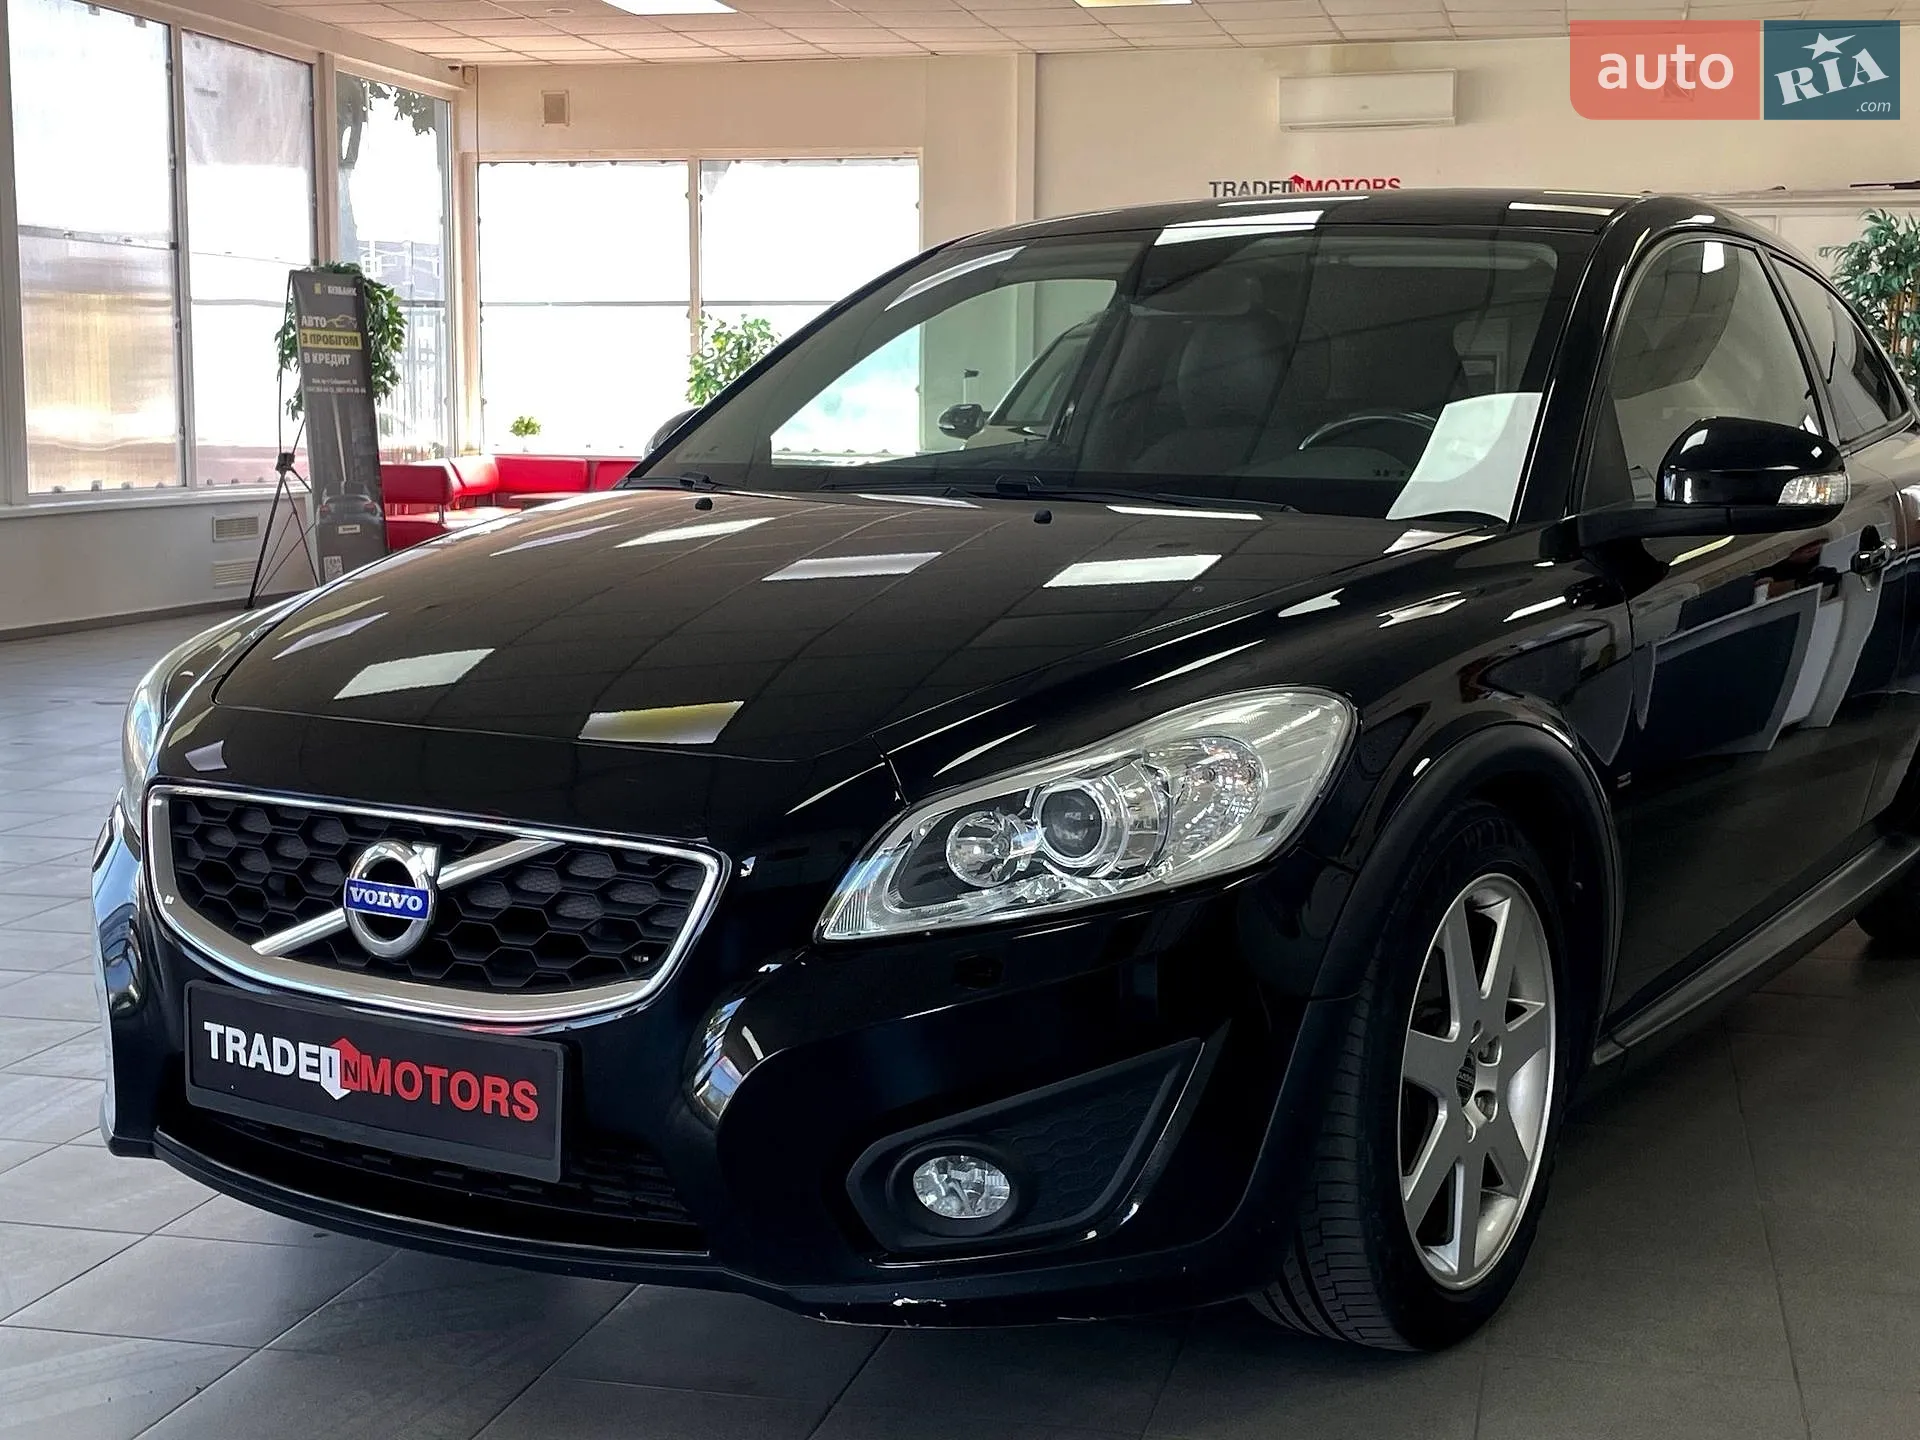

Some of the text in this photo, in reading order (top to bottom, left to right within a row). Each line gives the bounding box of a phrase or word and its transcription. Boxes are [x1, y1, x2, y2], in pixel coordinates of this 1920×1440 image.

[301, 315, 328, 328] АВТО
[301, 332, 359, 347] З ПРОБІГОМ
[303, 352, 351, 367] В КРЕДИТ
[349, 886, 423, 911] VOLVO
